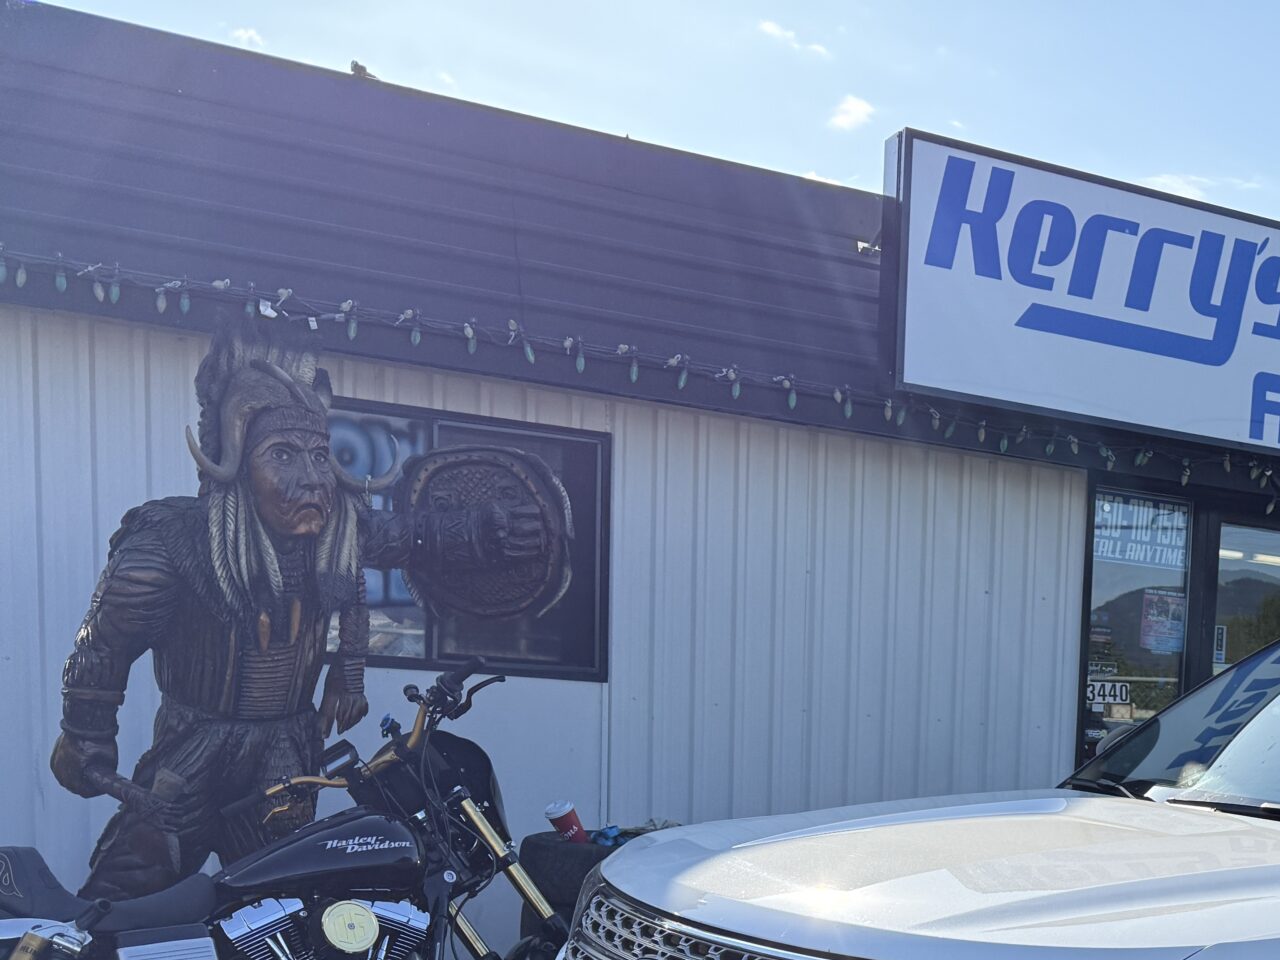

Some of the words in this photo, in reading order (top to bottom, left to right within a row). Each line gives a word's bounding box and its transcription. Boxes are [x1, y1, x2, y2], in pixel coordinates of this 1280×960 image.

[1125, 542, 1187, 567] ANYTIME
[1087, 683, 1129, 702] 3440
[345, 841, 413, 853] Davidson
